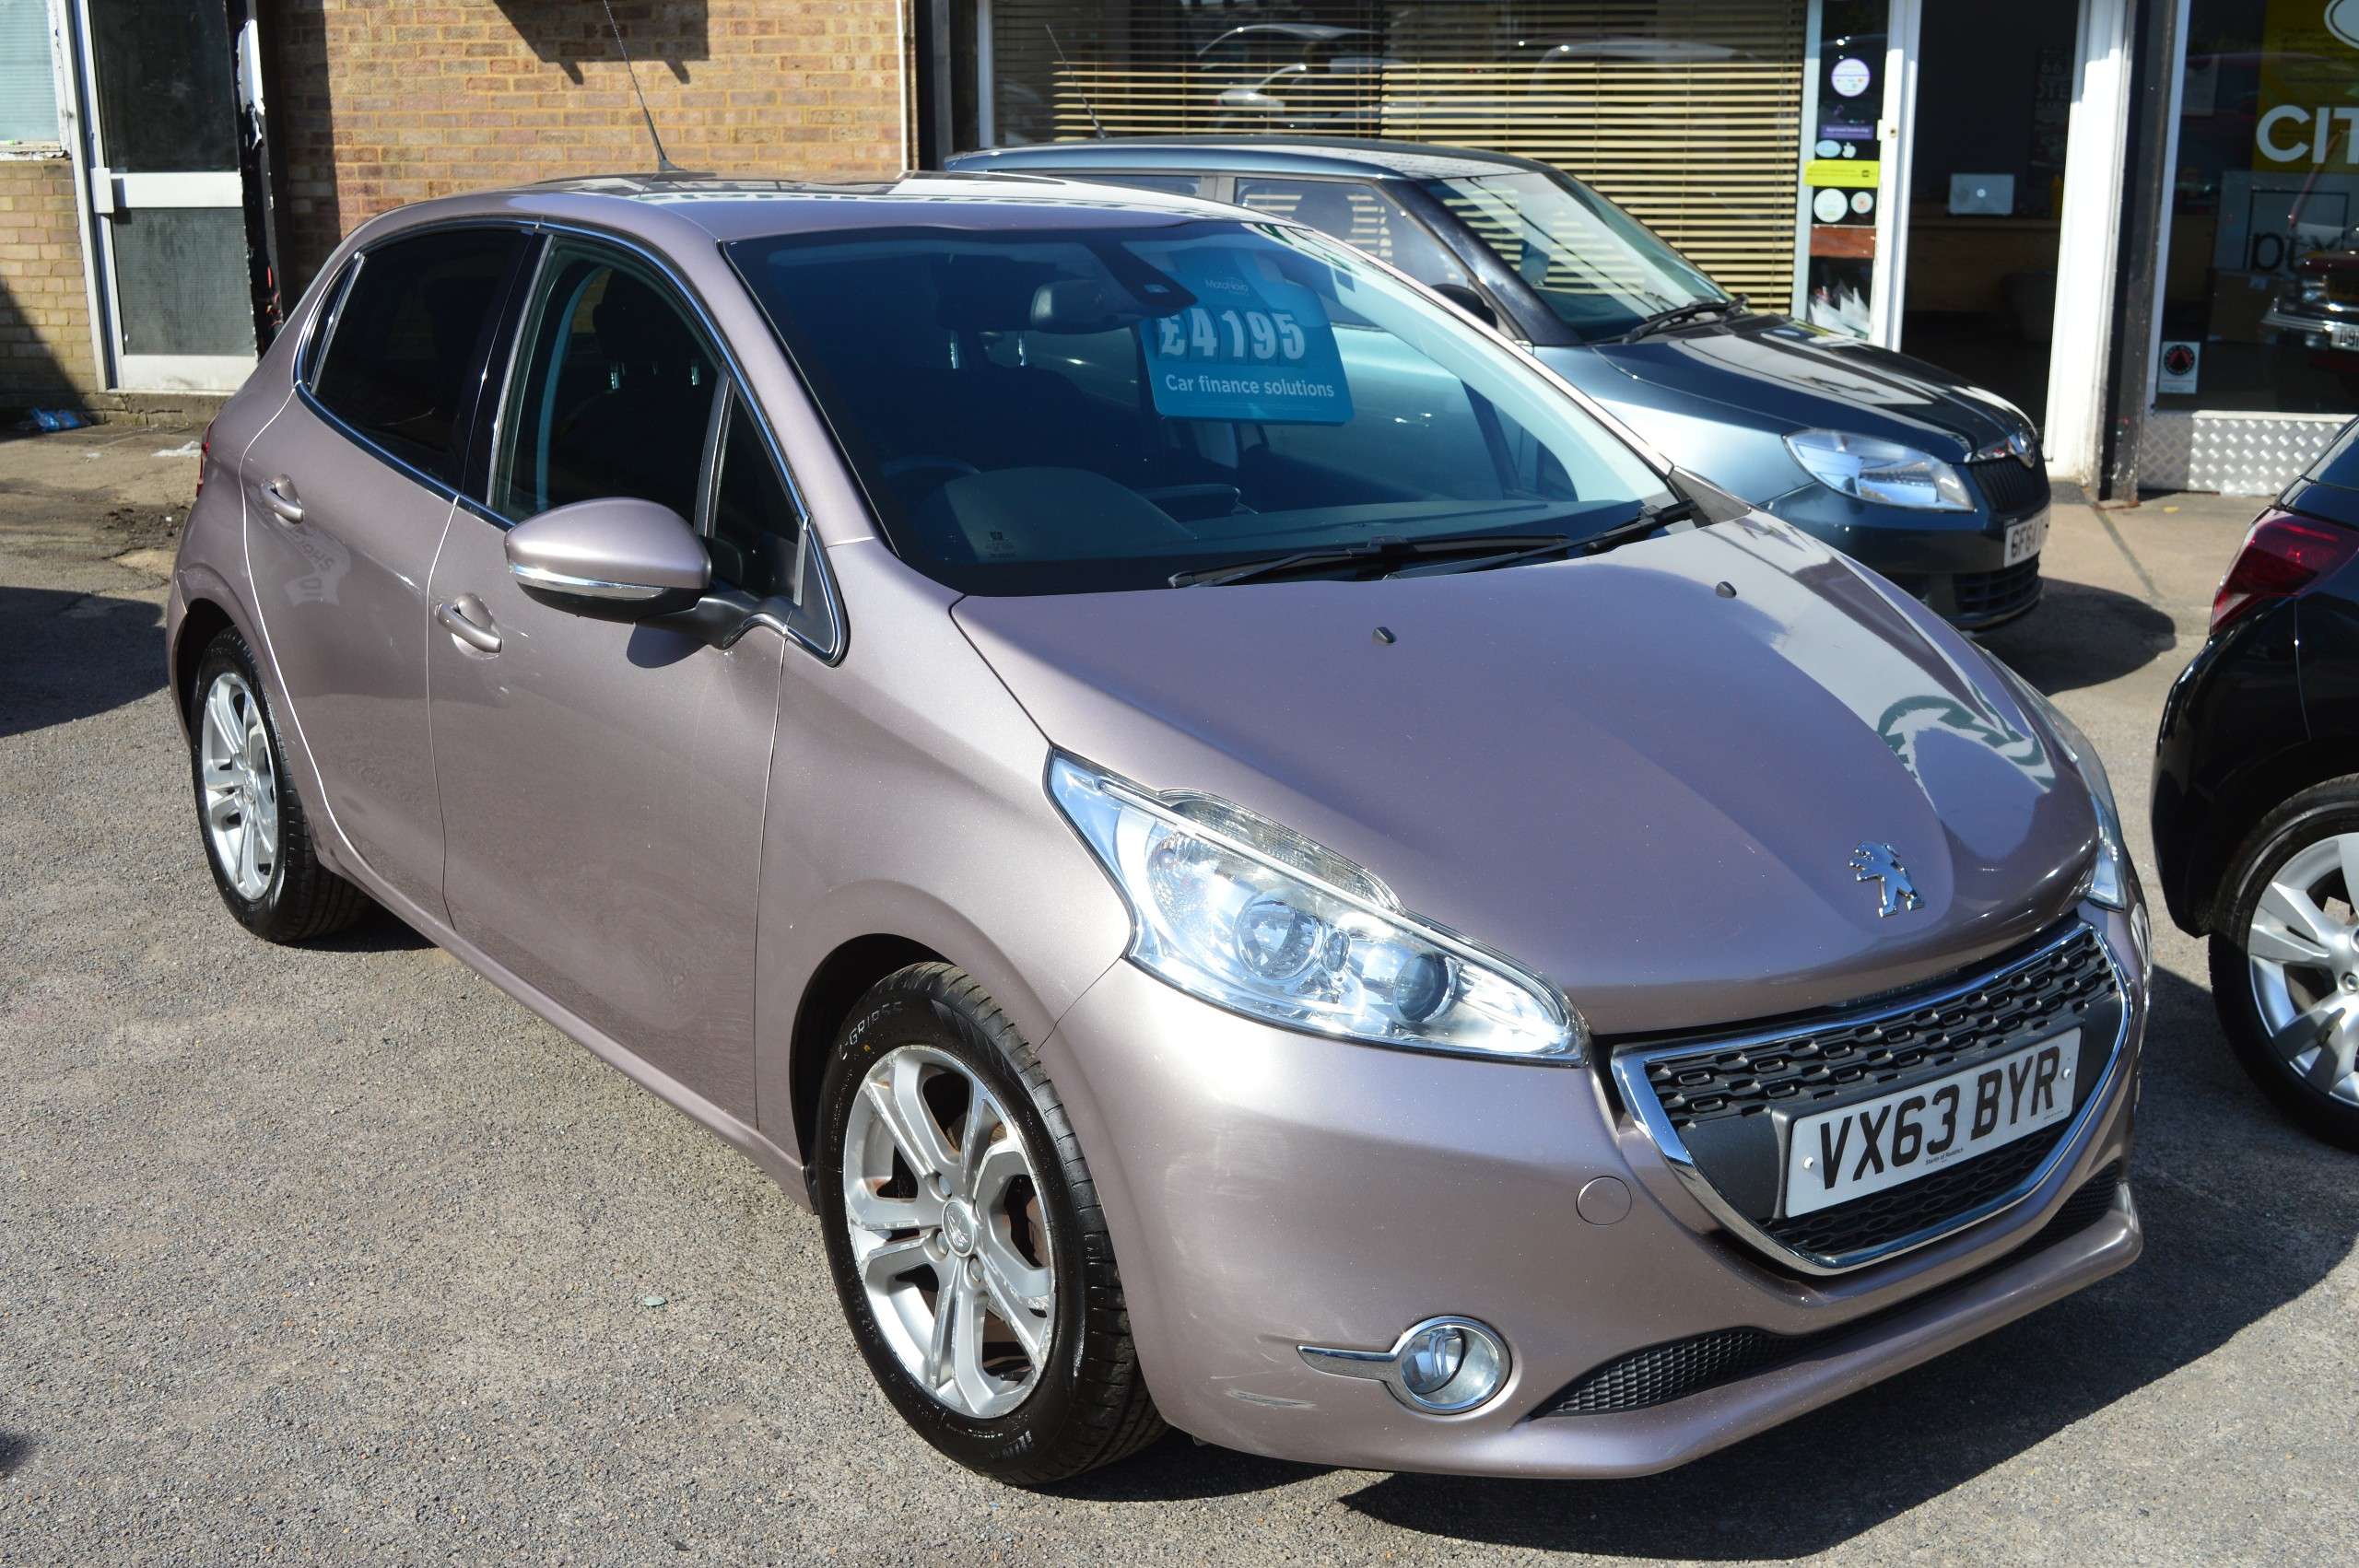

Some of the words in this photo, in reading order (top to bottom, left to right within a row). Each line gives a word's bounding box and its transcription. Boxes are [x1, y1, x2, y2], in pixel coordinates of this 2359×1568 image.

[1158, 308, 1305, 359] £4195
[1165, 374, 1194, 392] Car
[1198, 375, 1260, 394] finance
[1264, 378, 1335, 398] solutions
[1819, 1083, 1961, 1190] VX63
[1969, 1046, 2060, 1141] BYR
